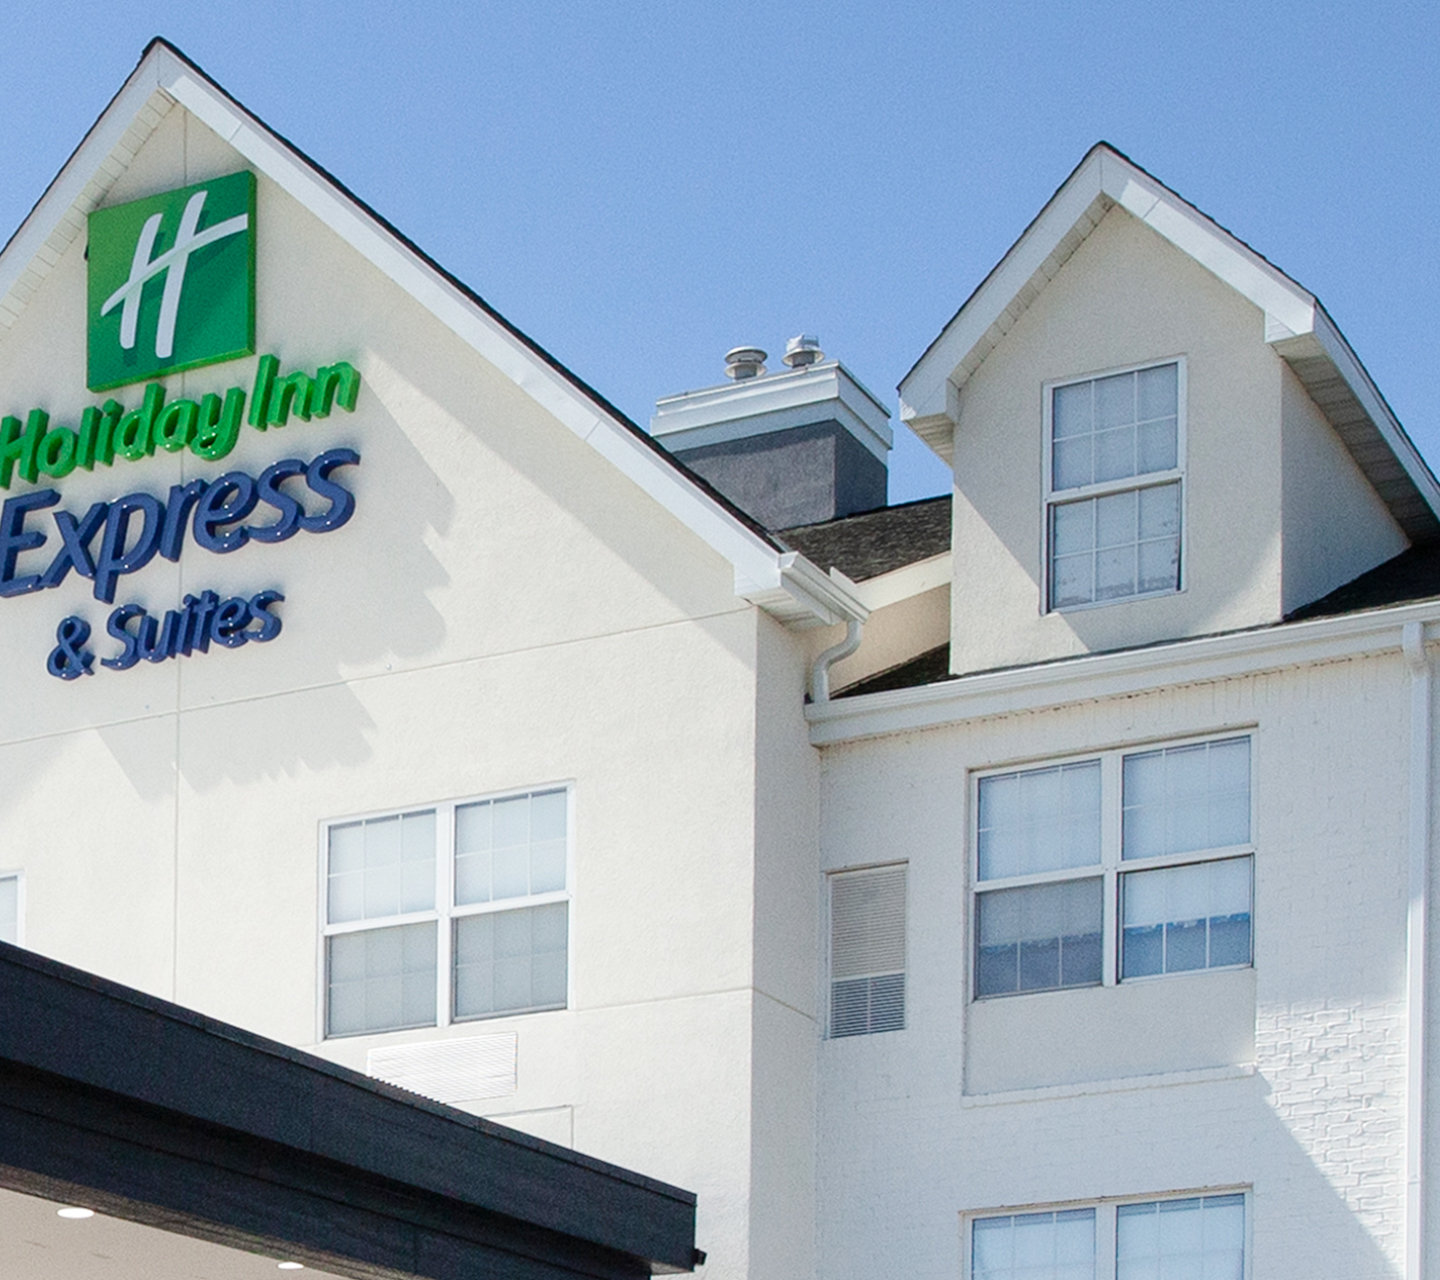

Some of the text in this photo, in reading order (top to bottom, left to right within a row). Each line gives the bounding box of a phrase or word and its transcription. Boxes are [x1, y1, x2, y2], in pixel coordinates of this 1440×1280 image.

[248, 353, 361, 432] Inn
[46, 590, 285, 680] & Suites
